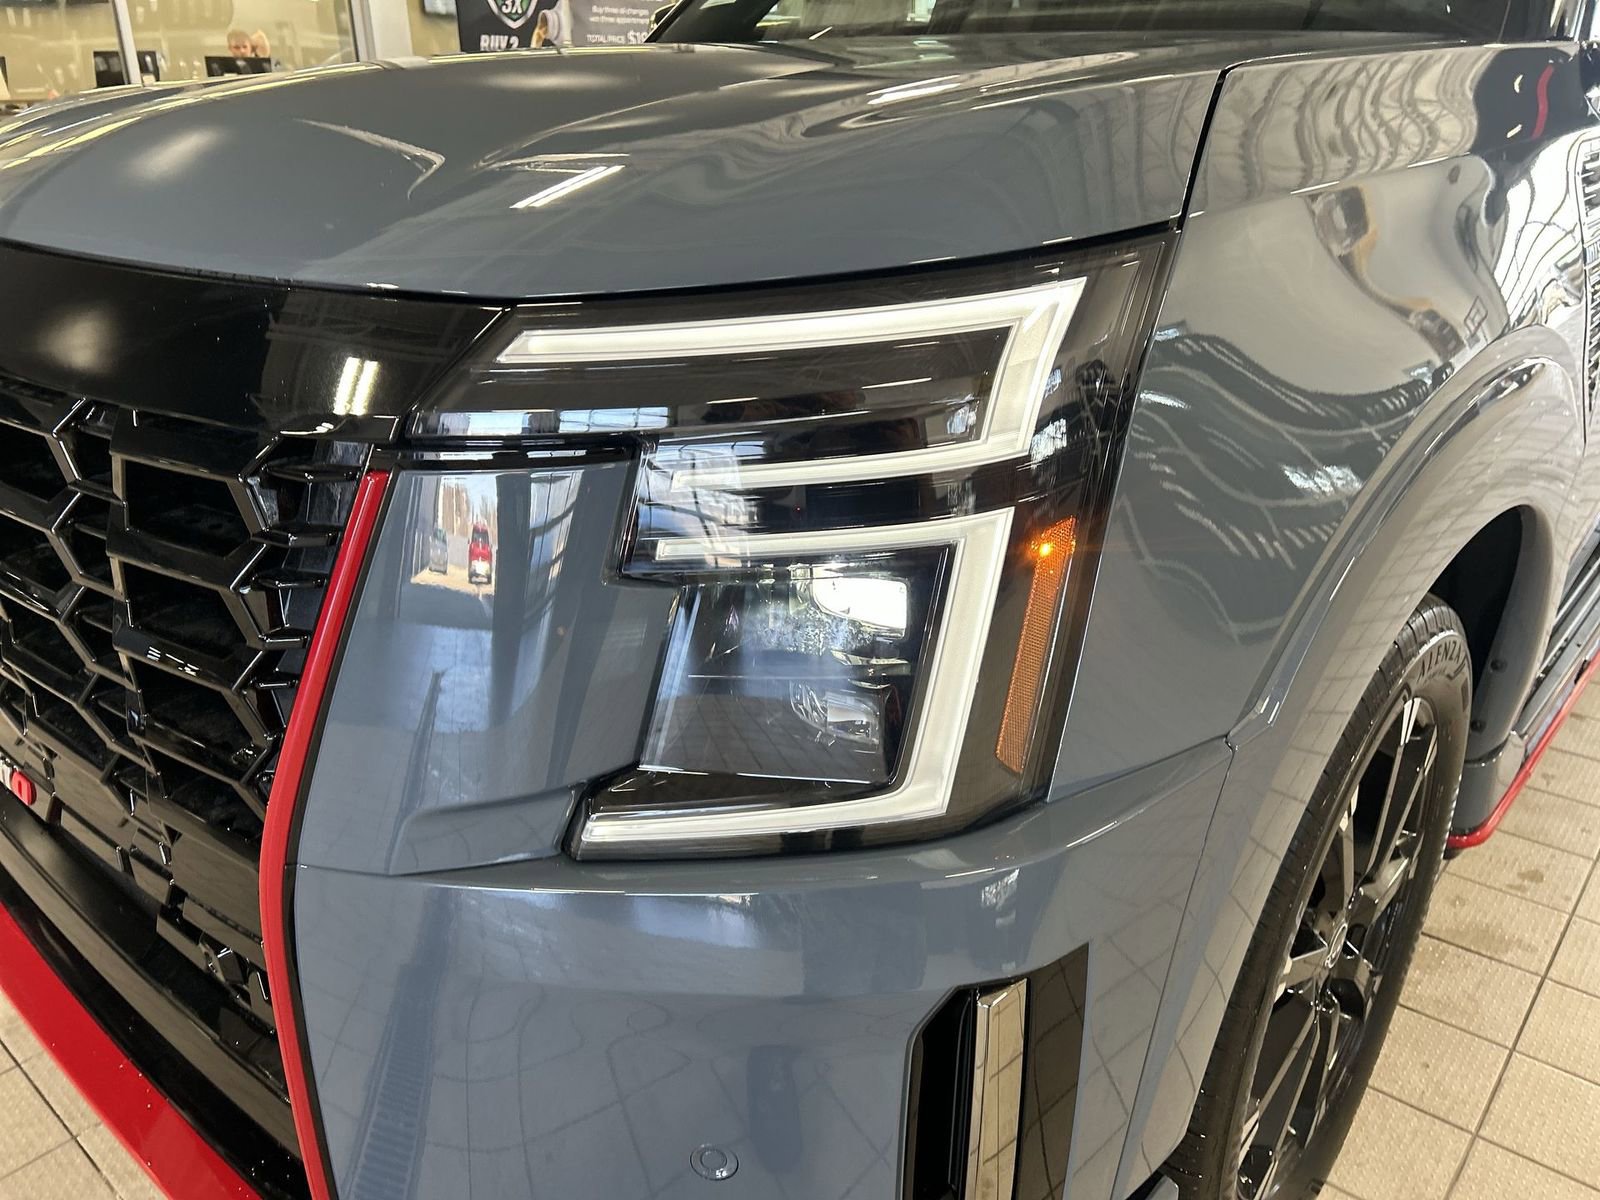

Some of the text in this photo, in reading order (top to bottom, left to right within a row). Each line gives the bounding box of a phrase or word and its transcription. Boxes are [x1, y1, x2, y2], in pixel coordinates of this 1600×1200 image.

[501, 0, 522, 14] 3X
[586, 33, 608, 43] TOTAL
[608, 35, 625, 44] PRICE
